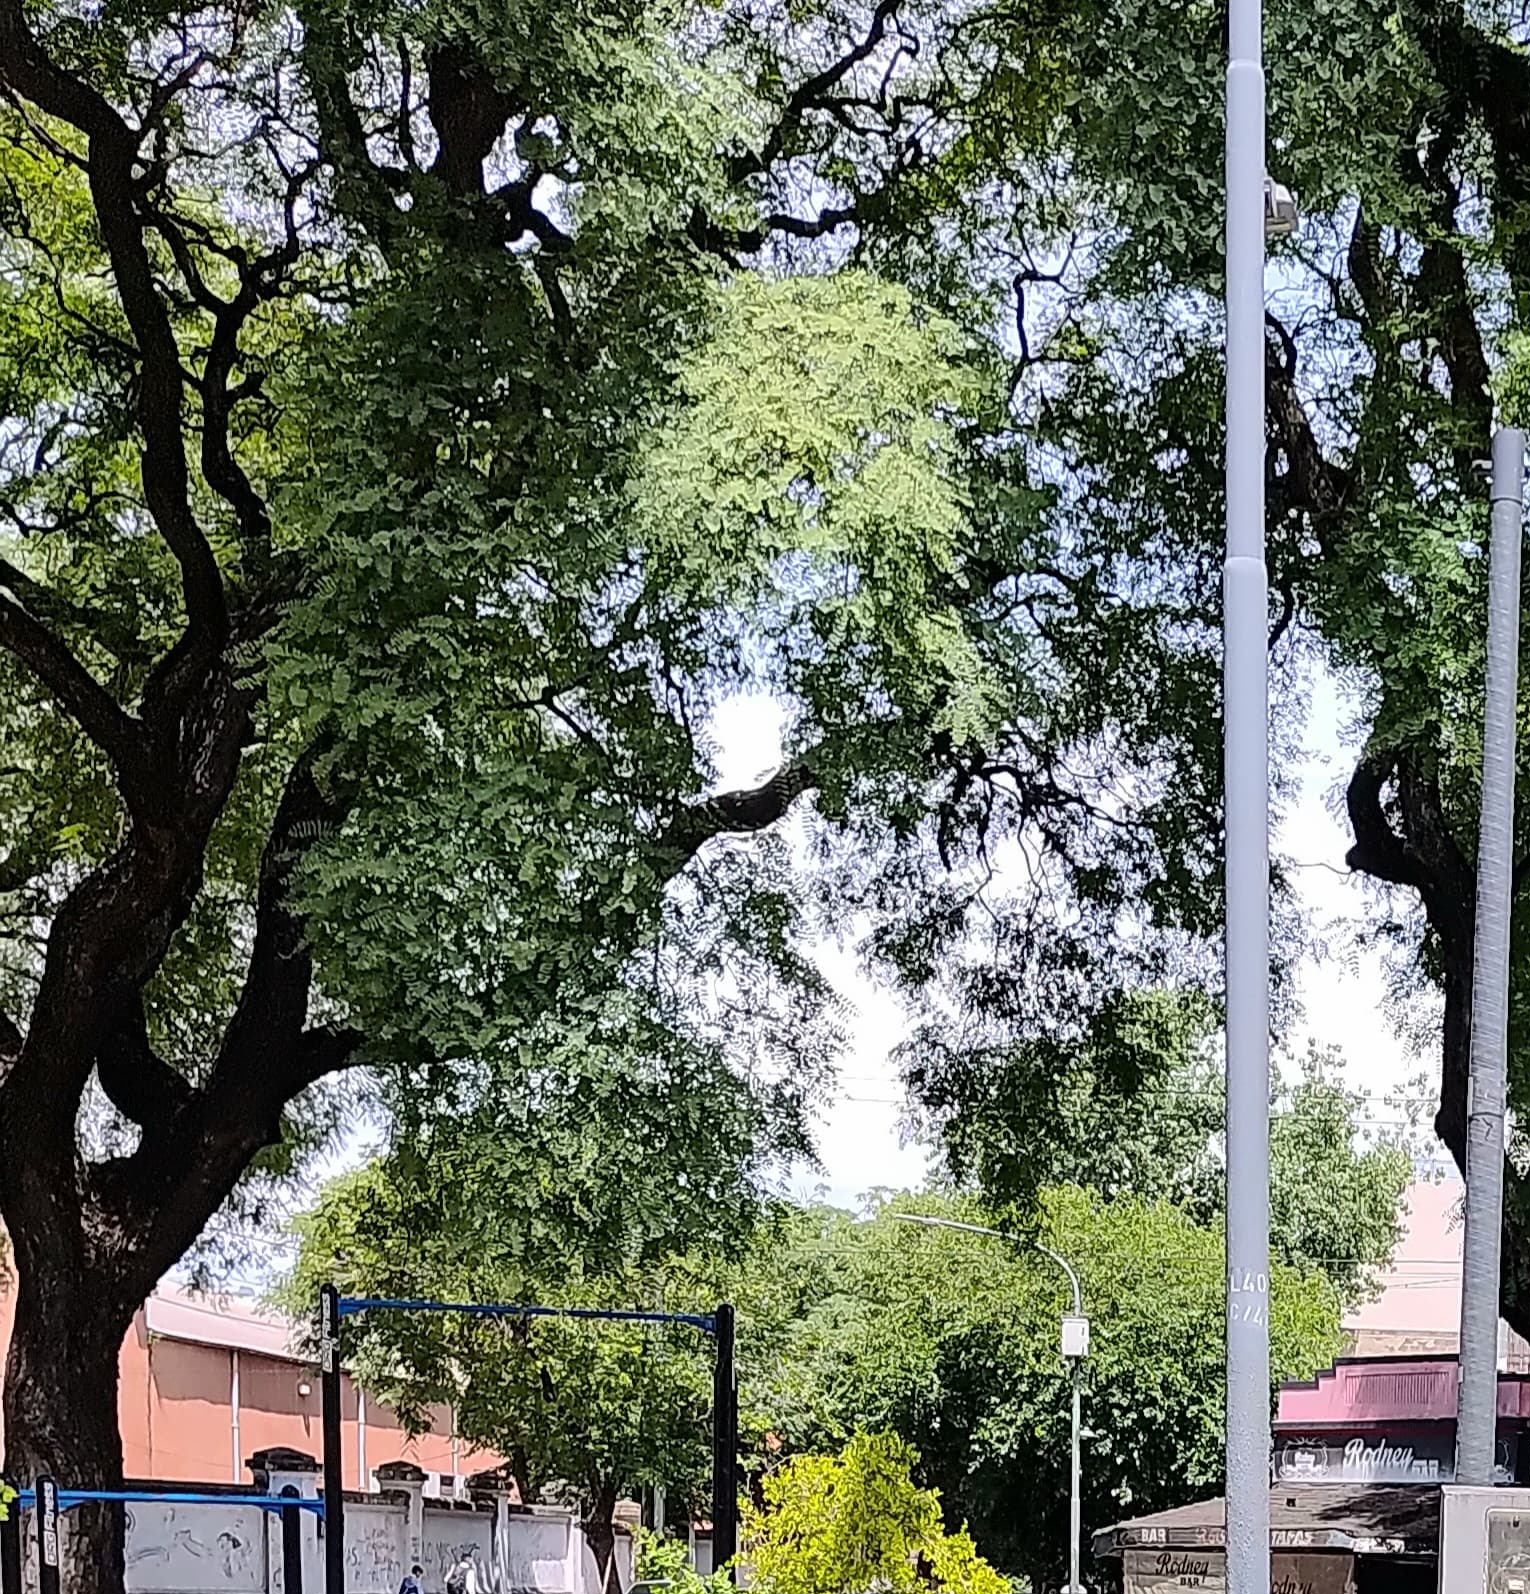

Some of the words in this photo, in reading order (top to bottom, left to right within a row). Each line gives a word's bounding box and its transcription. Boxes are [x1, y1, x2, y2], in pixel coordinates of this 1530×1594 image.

[1230, 1272, 1266, 1293] L40
[1343, 1438, 1414, 1473] Rodney
[1141, 1528, 1166, 1543] BAR
[1155, 1552, 1209, 1584] Rodney
